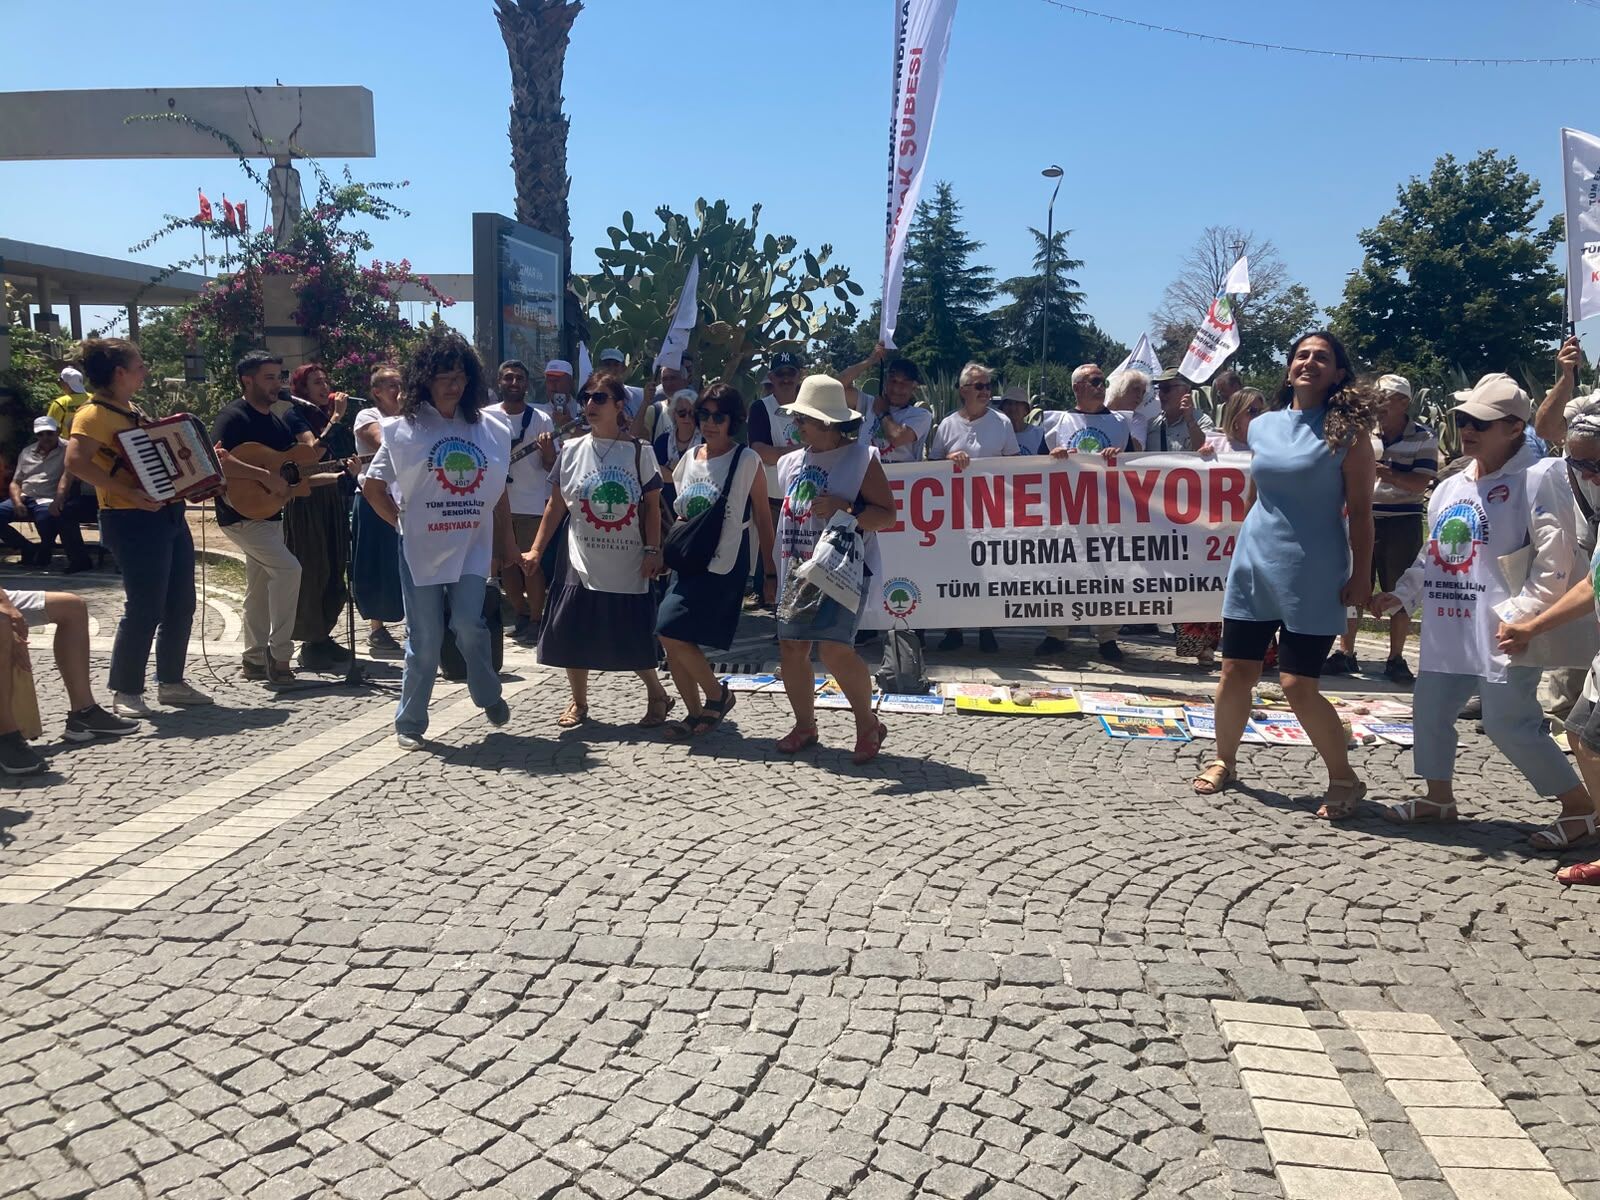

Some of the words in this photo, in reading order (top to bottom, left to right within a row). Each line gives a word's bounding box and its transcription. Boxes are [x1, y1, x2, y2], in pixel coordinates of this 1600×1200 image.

[1581, 244, 1600, 256] TÜ
[428, 521, 472, 533] KARŞIYAKA
[971, 538, 1077, 566] OTURMA
[1086, 529, 1189, 562] EYLEMİ!
[936, 580, 980, 598] TÜM
[988, 575, 1124, 597] EMEKLİLERİN
[1132, 573, 1227, 594] SENDİKA
[1004, 599, 1064, 618] İZMİR
[1071, 597, 1173, 621] ŞUBELERİ
[1437, 607, 1472, 618] BUCA
